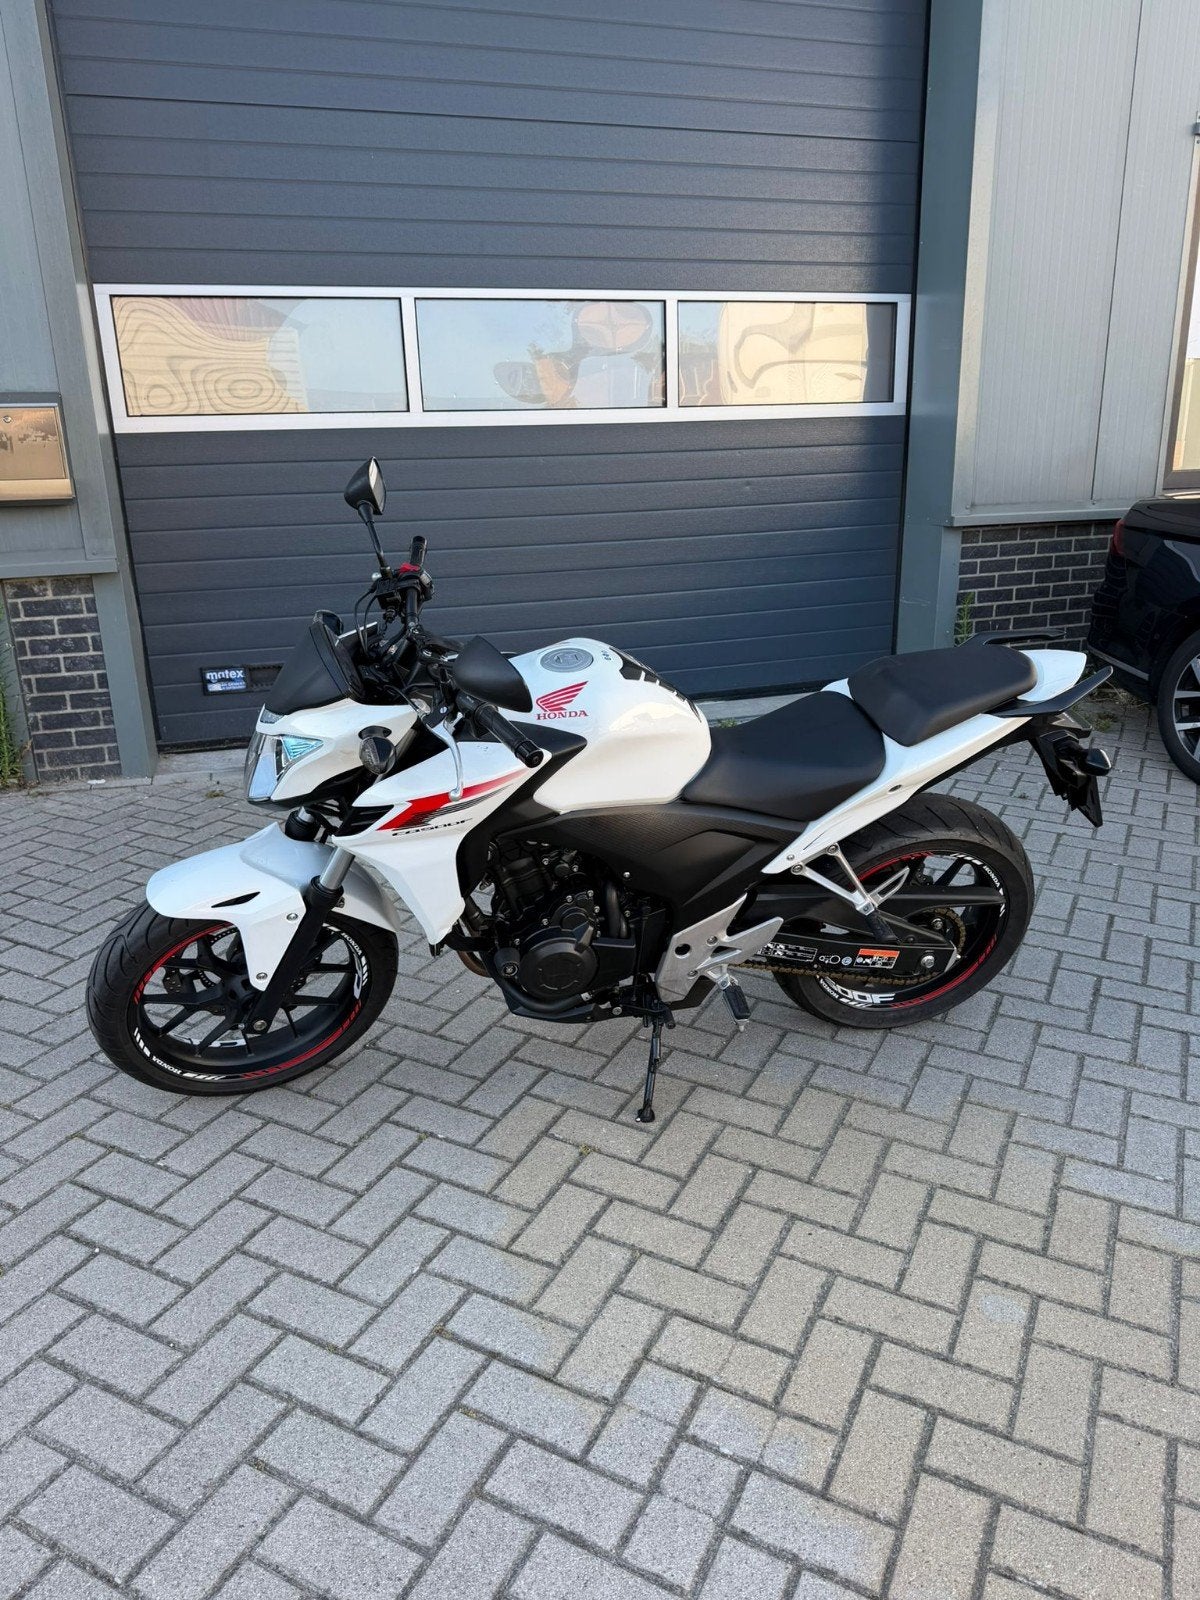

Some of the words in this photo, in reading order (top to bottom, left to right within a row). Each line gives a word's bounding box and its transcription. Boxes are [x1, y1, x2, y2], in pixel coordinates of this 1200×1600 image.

[206, 669, 244, 680] matex
[537, 710, 588, 720] HONDA
[983, 865, 1000, 888] HONDA
[341, 932, 362, 956] HONDA
[819, 978, 839, 999] HONDA
[152, 1055, 183, 1075] HONDA
